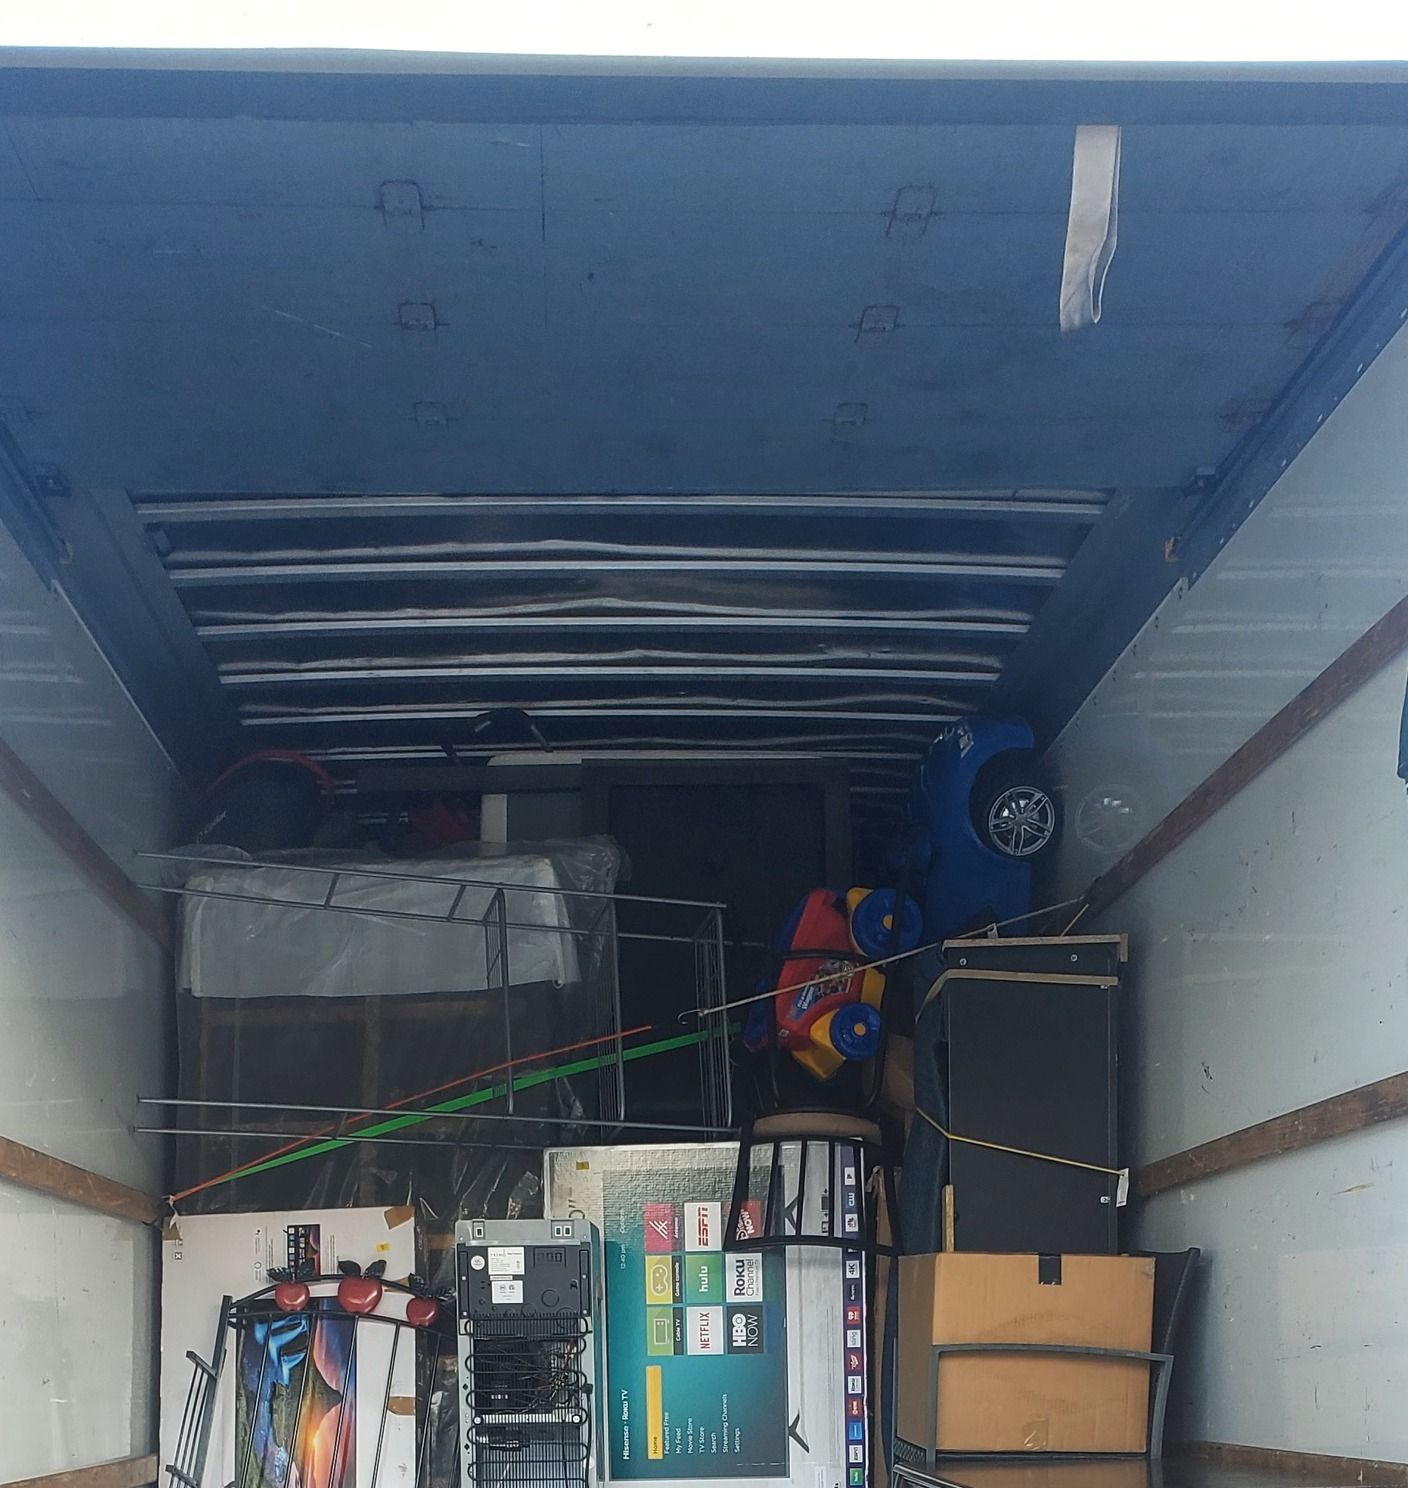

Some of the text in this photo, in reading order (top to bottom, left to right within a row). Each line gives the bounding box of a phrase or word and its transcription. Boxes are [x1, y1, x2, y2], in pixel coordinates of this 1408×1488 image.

[697, 1207, 708, 1246] ESPN
[698, 1265, 709, 1292] hulu
[745, 1258, 754, 1297] Channel
[846, 1264, 855, 1275] 4K
[699, 1312, 710, 1349] NETFLIX
[732, 1313, 746, 1347] HBO
[746, 1314, 758, 1347] NOW
[621, 1389, 628, 1400] TV
[622, 1426, 630, 1460] Hisense
[675, 1445, 682, 1454] My
[699, 1445, 705, 1453] TV
